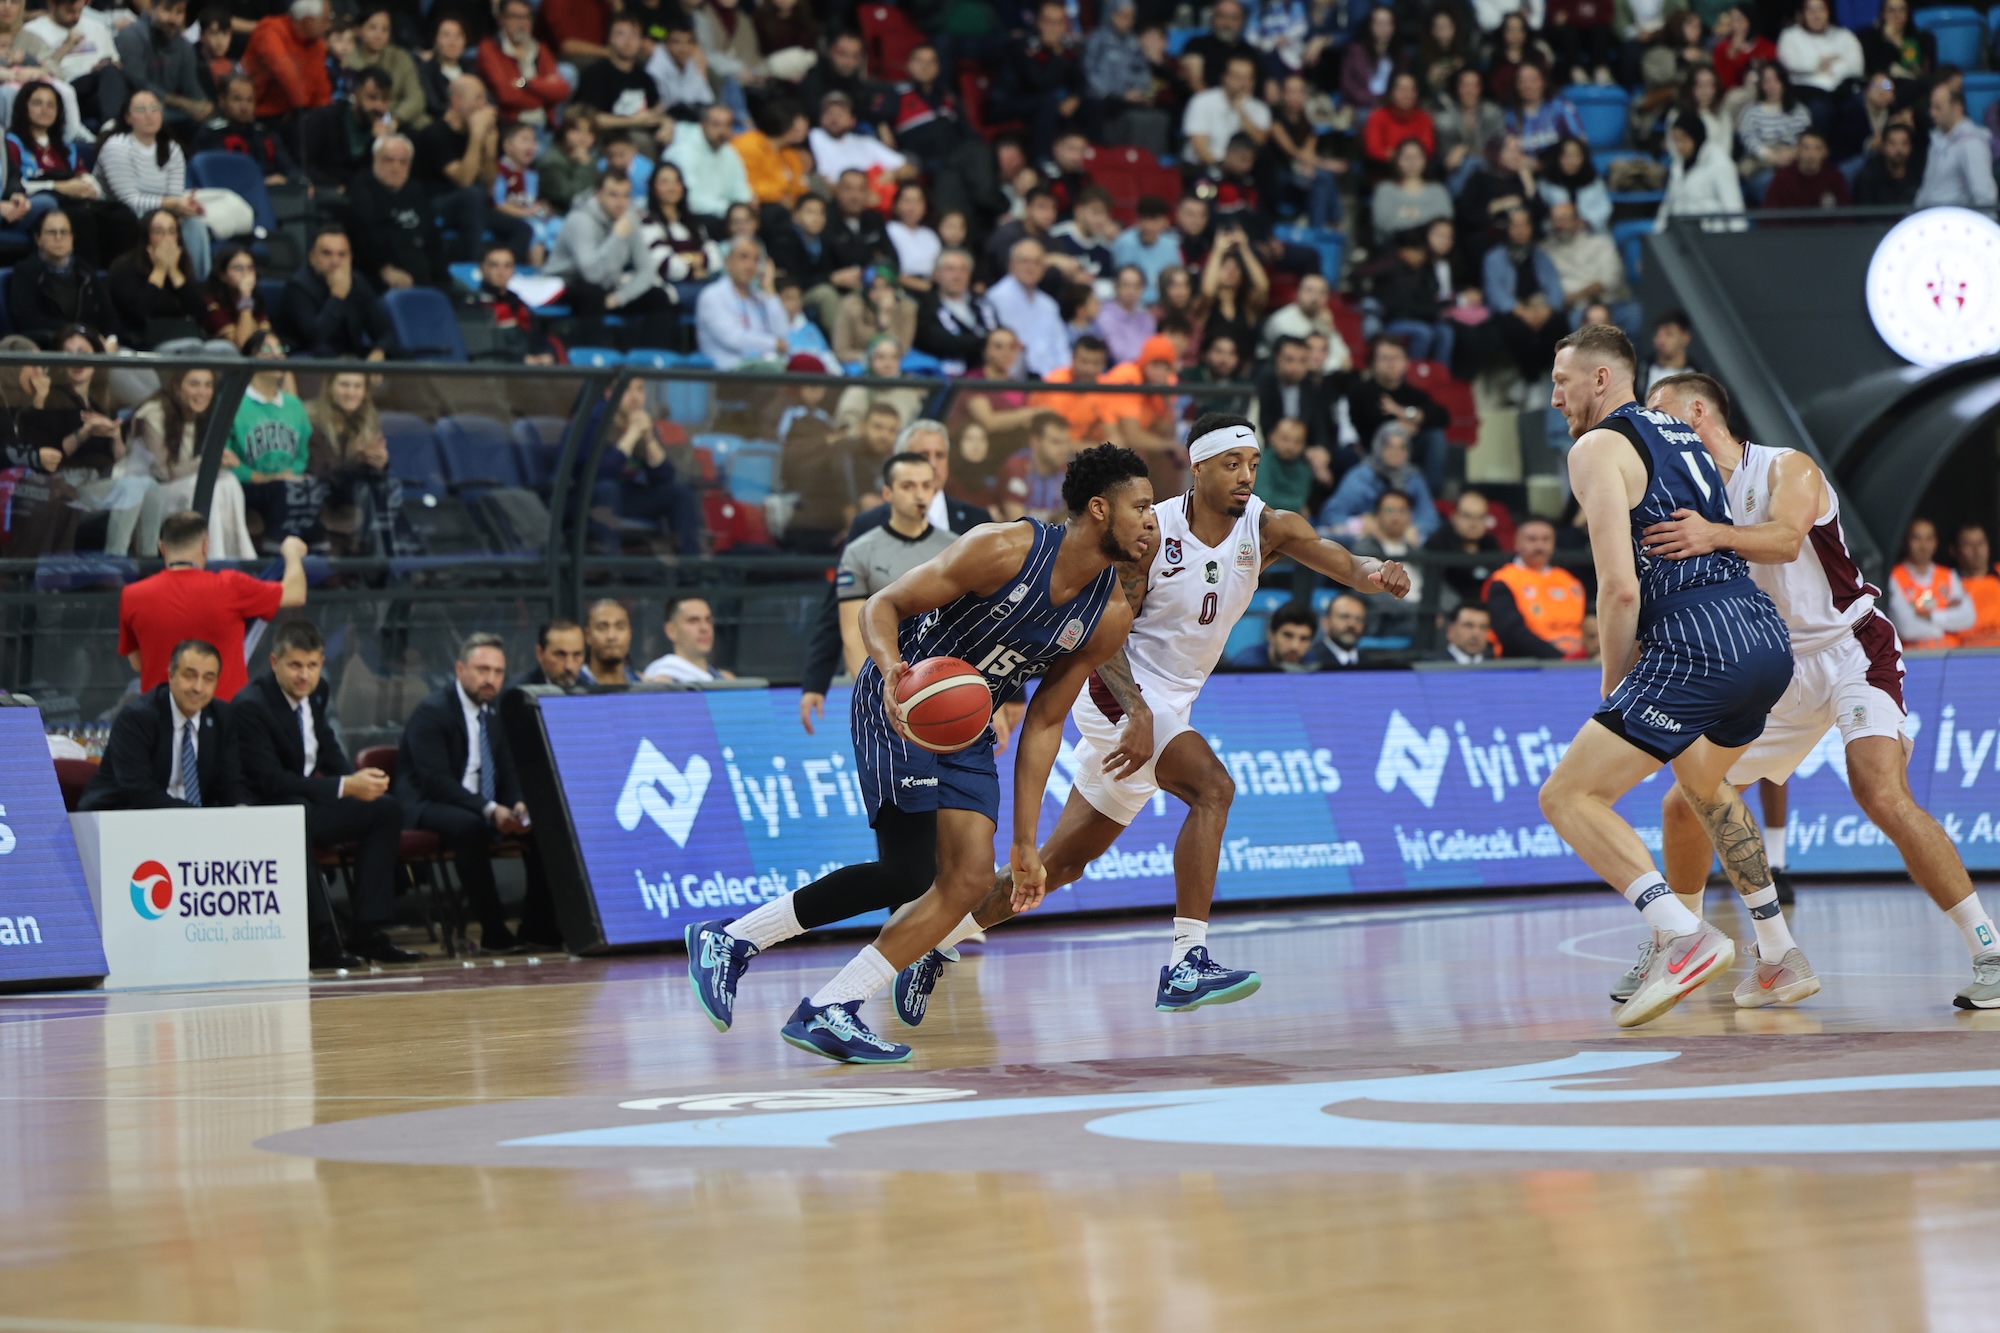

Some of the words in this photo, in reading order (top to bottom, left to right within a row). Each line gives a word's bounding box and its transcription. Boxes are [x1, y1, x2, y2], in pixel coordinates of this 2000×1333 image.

[1198, 592, 1218, 625] 0
[975, 644, 1028, 677] 15
[1642, 705, 1682, 731] HSM
[1209, 734, 1341, 795] inans
[1454, 719, 1520, 803] İyi
[722, 746, 802, 838] İyi
[1786, 809, 1828, 855] İyi
[1227, 836, 1364, 872] Finansman
[178, 860, 278, 887] TÜRKİYE
[179, 890, 281, 918] SİGORTA
[634, 868, 680, 919] İyi
[680, 868, 789, 908] Gelecek
[1642, 884, 1673, 902] GSA
[184, 921, 229, 946] Gücü,
[232, 919, 286, 941] adında.
